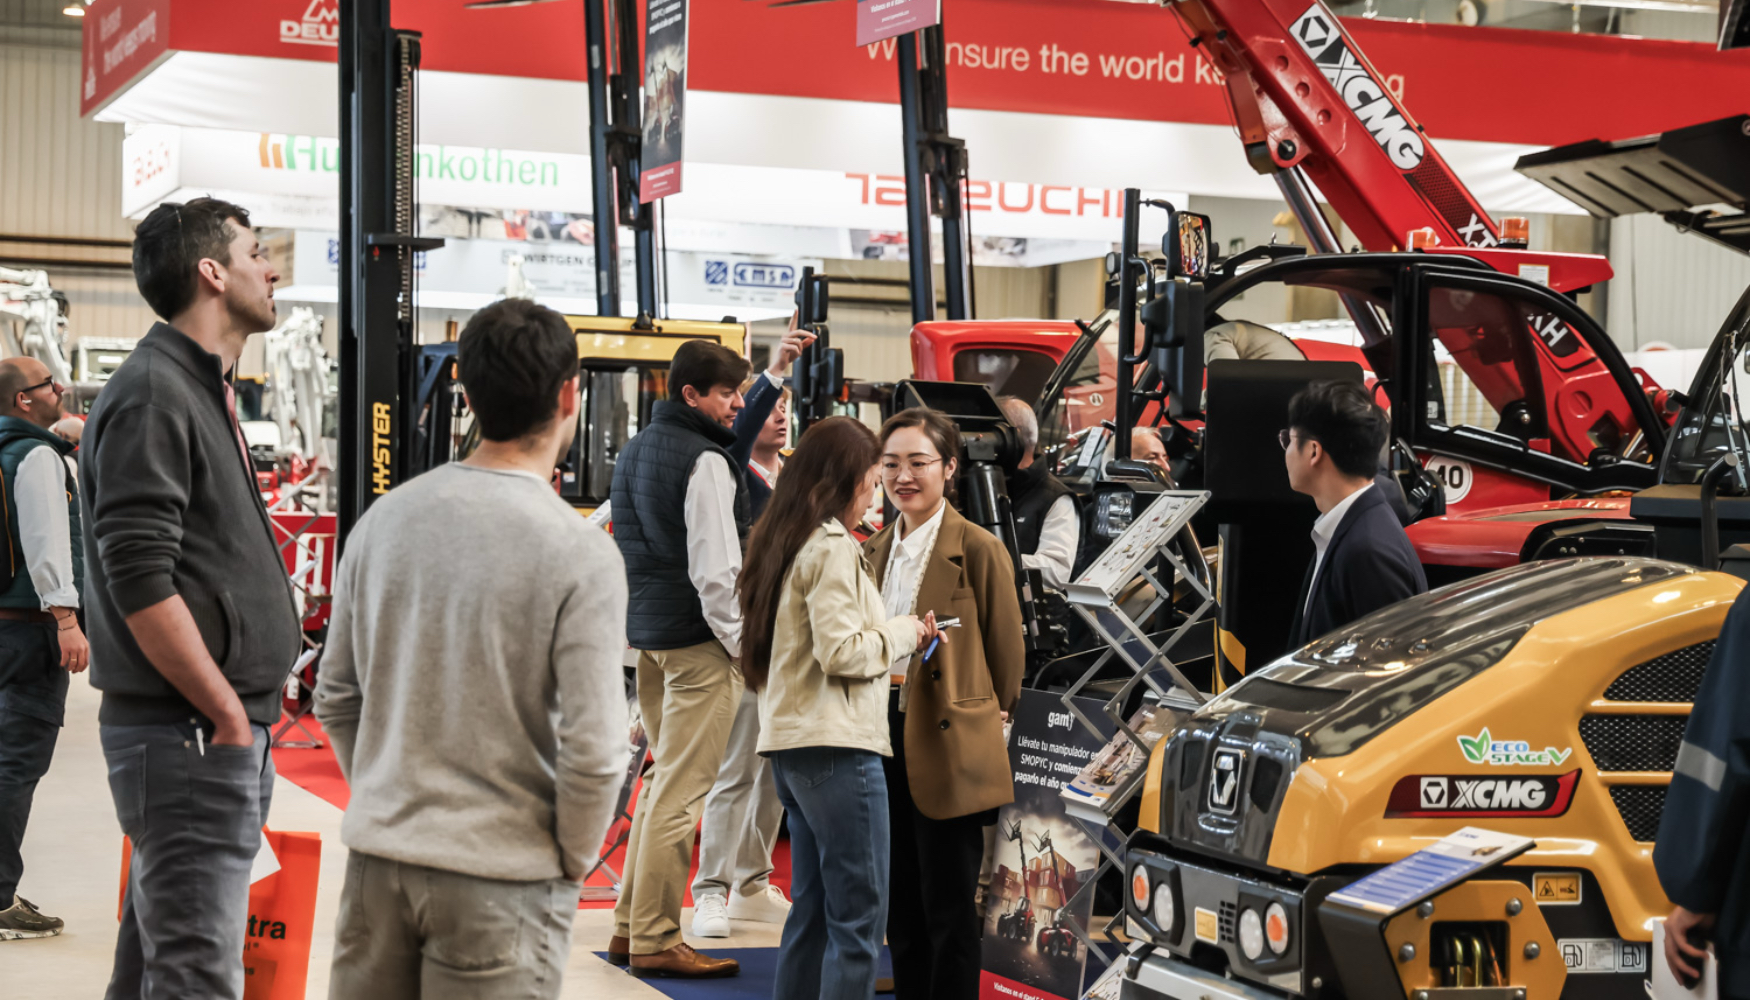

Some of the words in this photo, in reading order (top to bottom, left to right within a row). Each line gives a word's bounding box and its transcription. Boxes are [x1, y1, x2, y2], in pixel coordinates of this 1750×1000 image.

[280, 20, 338, 40] DEU
[867, 36, 897, 61] W
[944, 42, 1030, 71] nsure
[1039, 43, 1089, 76] the
[1099, 52, 1184, 84] world
[1315, 45, 1424, 169] XCMG
[285, 134, 558, 187] Hunkothen
[372, 401, 391, 494] HYSTER
[1017, 735, 1040, 750] Llévate
[1041, 740, 1048, 752] tu
[1048, 743, 1090, 759] manipulador
[1491, 743, 1528, 752] ECO
[1020, 753, 1048, 769] SMOPYC
[1048, 761, 1054, 772] y
[1054, 762, 1083, 775] comienz
[1014, 771, 1039, 785] pagarlo
[1040, 775, 1047, 787] el
[1047, 776, 1060, 789] año
[1449, 779, 1546, 809] XCMG
